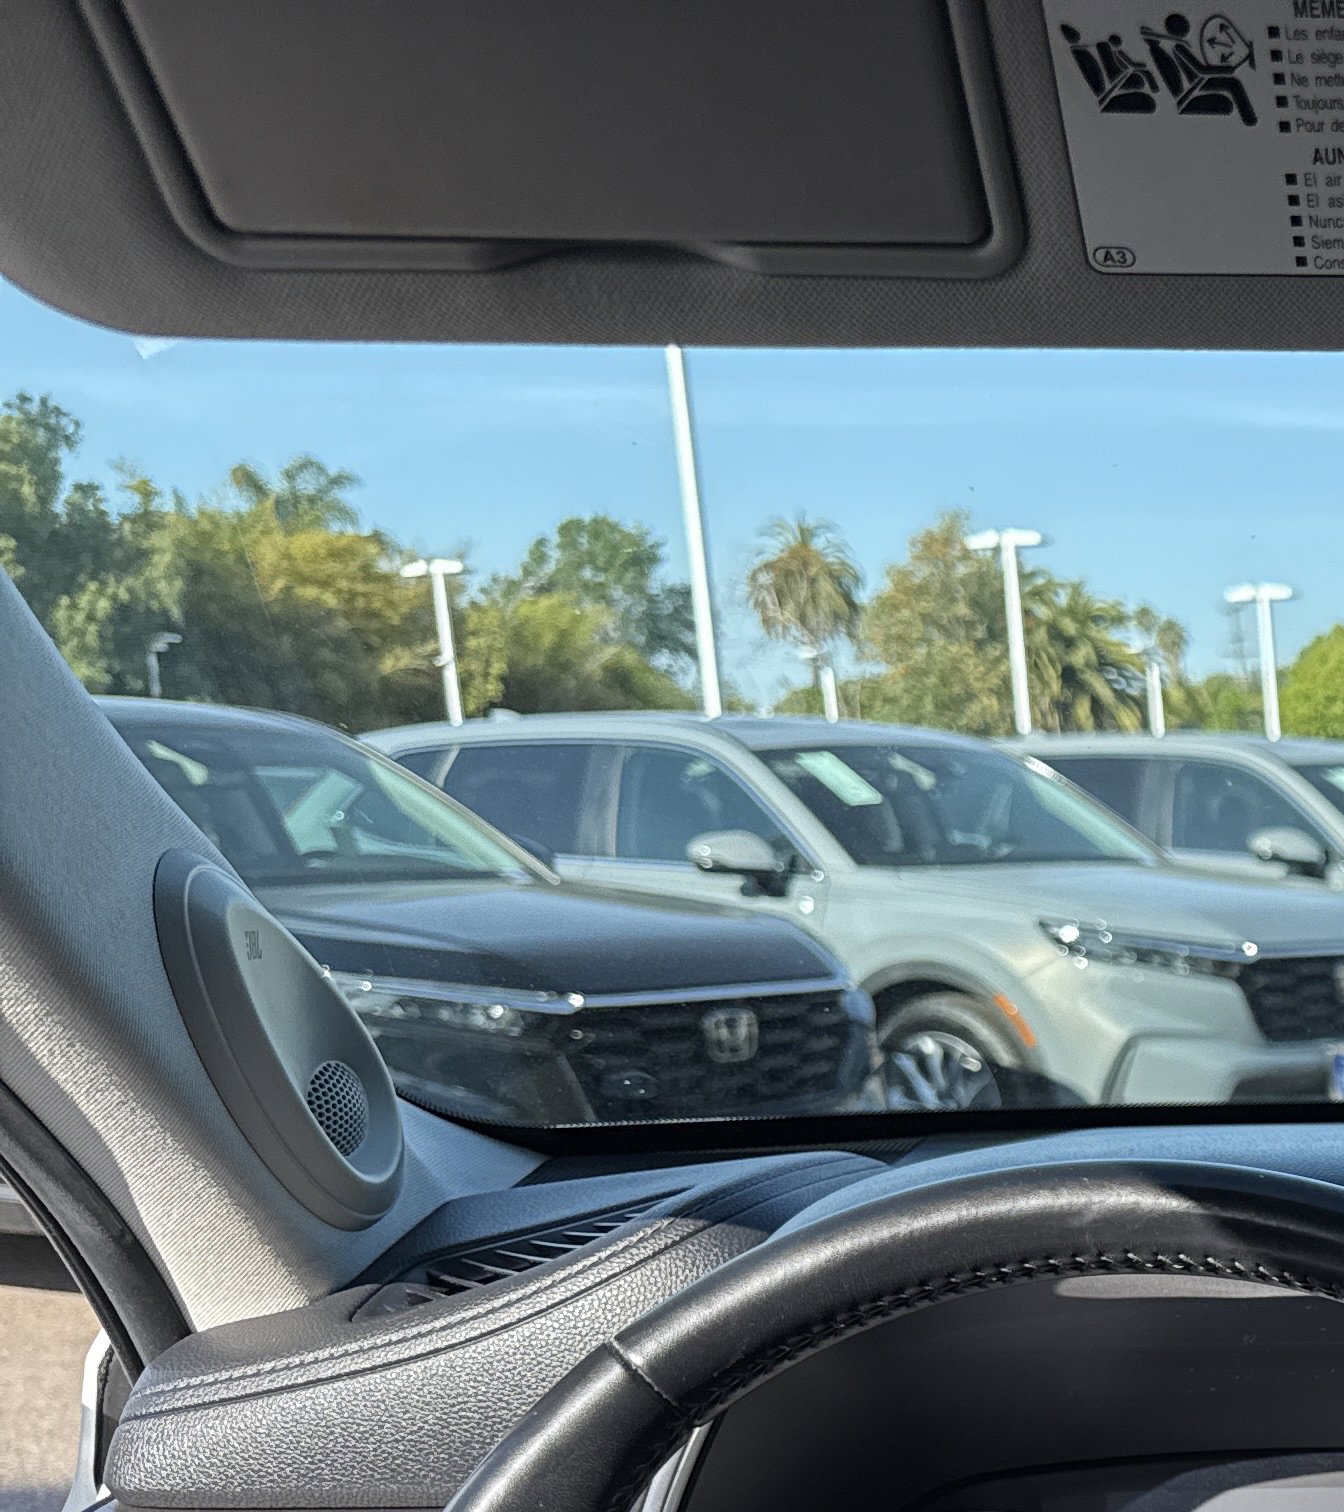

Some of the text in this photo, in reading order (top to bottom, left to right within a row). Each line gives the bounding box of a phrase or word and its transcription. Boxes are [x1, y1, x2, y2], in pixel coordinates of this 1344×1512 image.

[1284, 25, 1308, 41] Les
[1288, 50, 1304, 64] Le
[1290, 73, 1309, 88] Ne
[1296, 118, 1325, 133] Pour
[1303, 173, 1318, 187] El
[1325, 172, 1342, 187] air
[1306, 194, 1320, 208] El
[1102, 250, 1127, 265] A3
